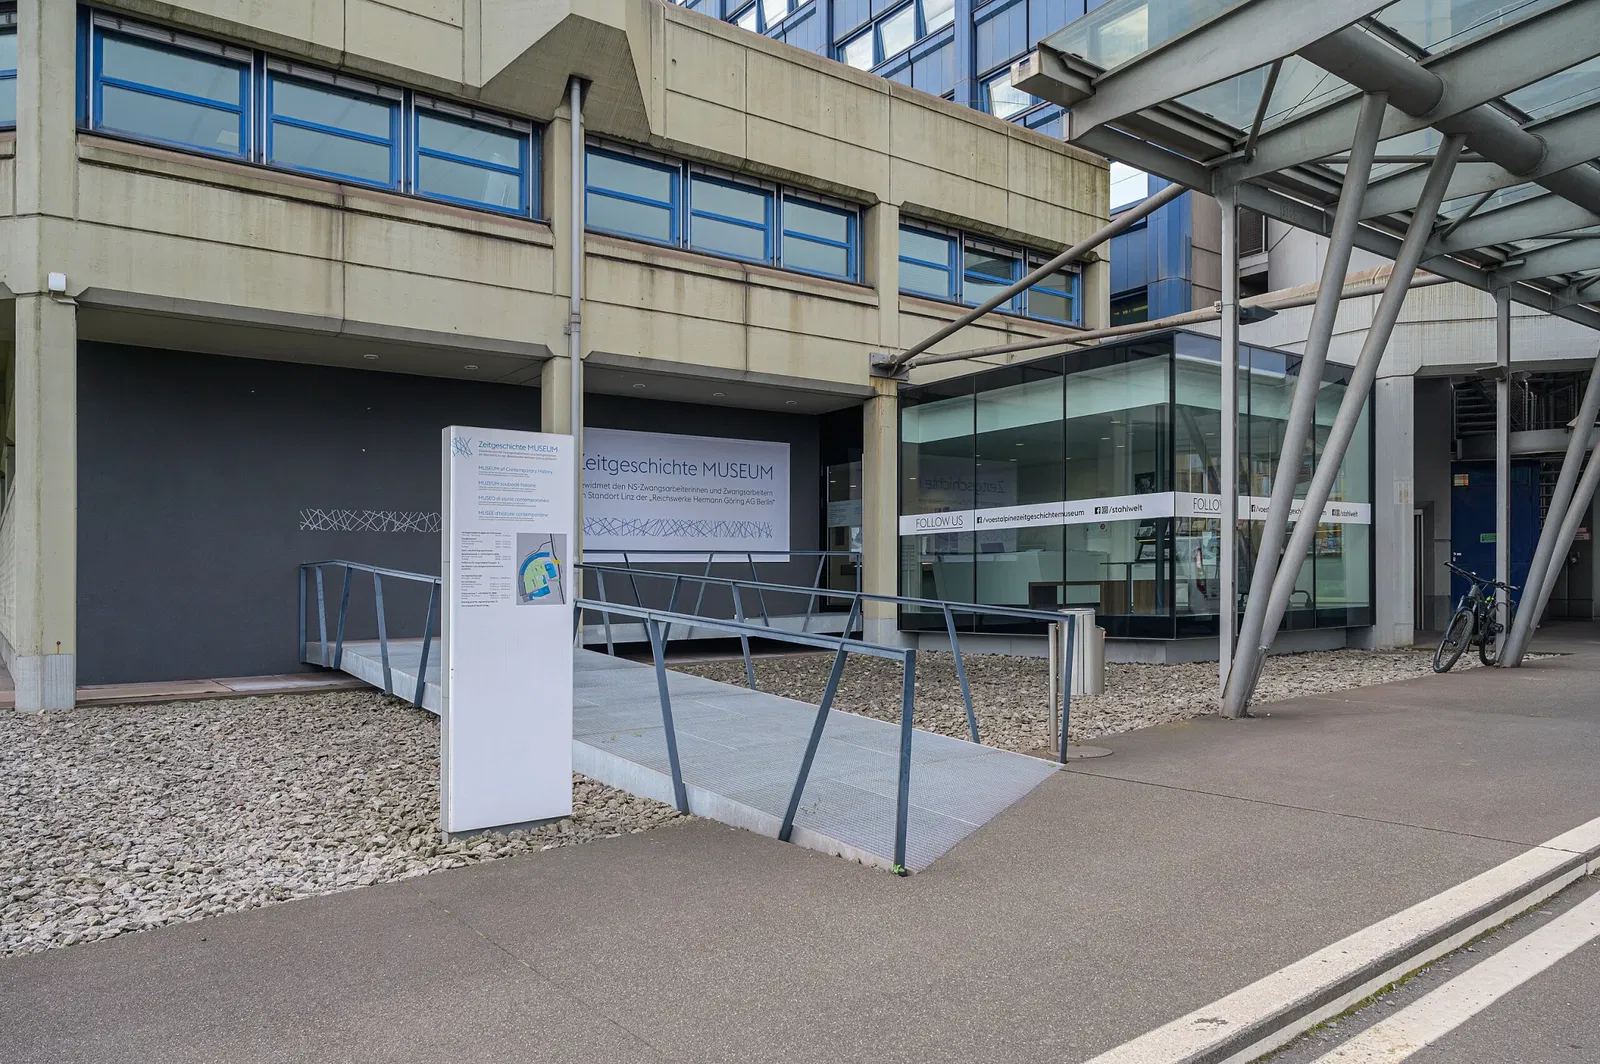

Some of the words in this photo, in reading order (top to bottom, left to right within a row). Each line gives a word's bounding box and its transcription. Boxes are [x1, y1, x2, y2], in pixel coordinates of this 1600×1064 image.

[478, 441, 527, 451] Zeitgeschichte
[527, 444, 558, 453] MUSEUM
[702, 461, 773, 480] MUSEUM
[612, 482, 626, 491] den
[627, 483, 709, 494] NS-Zwangsarbeiterinnen
[723, 487, 773, 496] Zwangsarbeitern
[588, 491, 619, 500] Standort
[621, 493, 634, 501] Linz
[636, 493, 648, 501] der
[692, 496, 723, 504] Hermann
[723, 496, 744, 506] Göring
[745, 498, 755, 506] AG
[1193, 498, 1221, 511] FOLLO
[1109, 504, 1143, 514] /stahlwelt
[915, 516, 951, 528] FOLLOW
[951, 515, 964, 526] US
